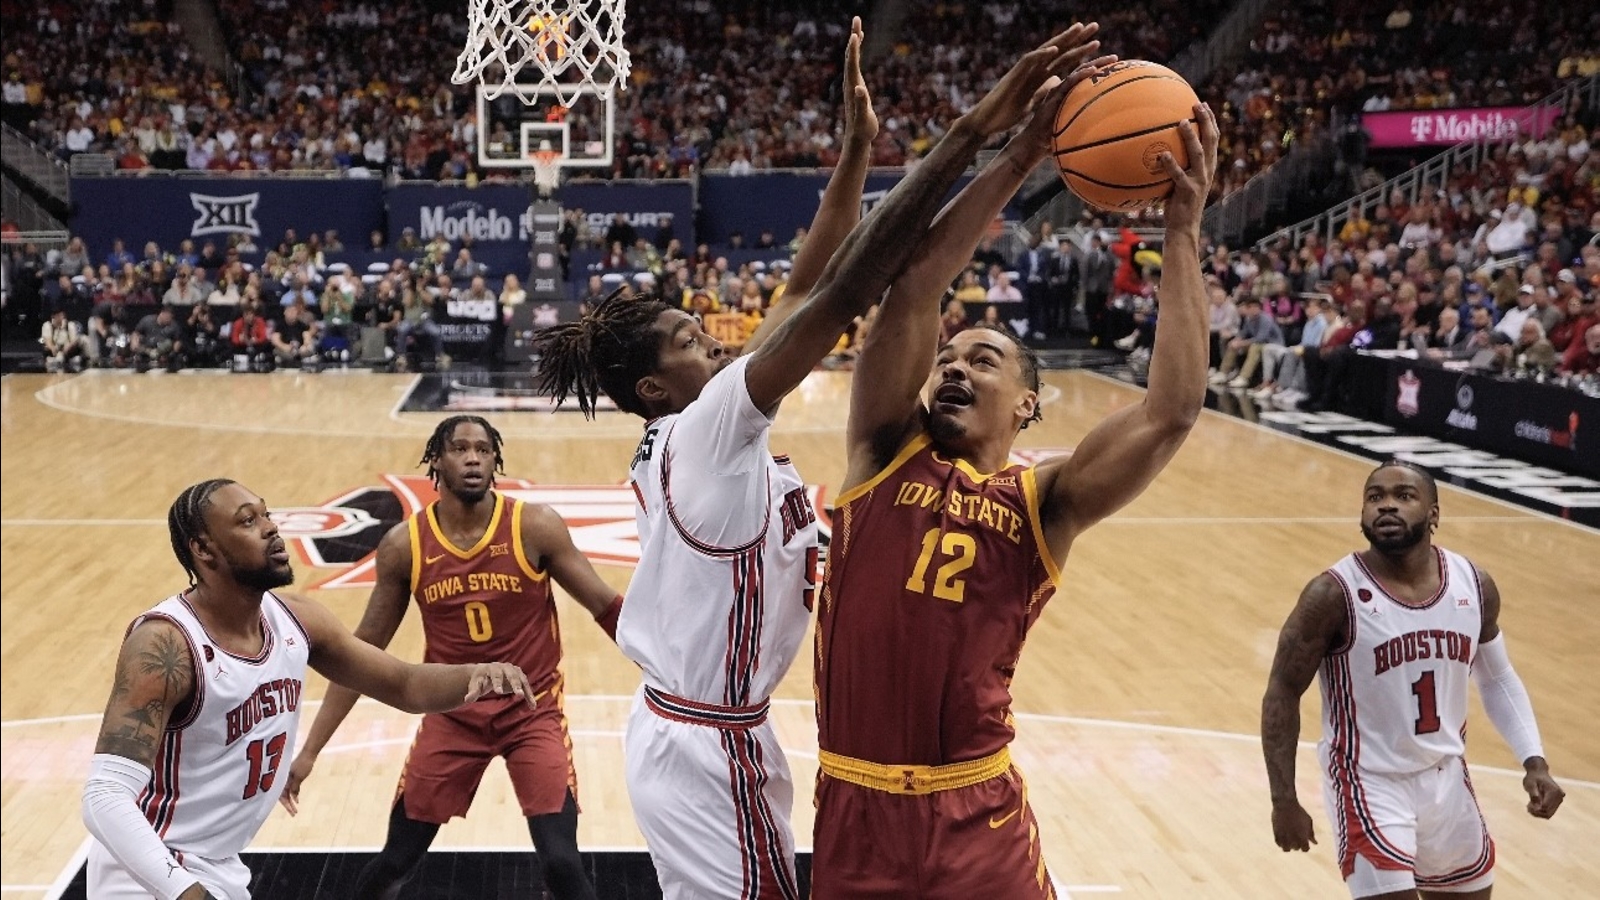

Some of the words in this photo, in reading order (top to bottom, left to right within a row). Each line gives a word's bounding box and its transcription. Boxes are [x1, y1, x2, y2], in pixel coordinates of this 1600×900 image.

[1435, 112, 1518, 141] Mobile
[194, 195, 257, 233] XII
[420, 206, 512, 240] Modelo
[894, 482, 945, 513] IOW
[948, 490, 1024, 545] STATE
[906, 528, 976, 603] 12
[424, 576, 464, 605] IOWA
[468, 573, 523, 594] STATE
[464, 601, 493, 643] 0
[1374, 629, 1472, 676] HOUSTON
[1411, 670, 1441, 736] 1
[242, 731, 287, 800] 13
